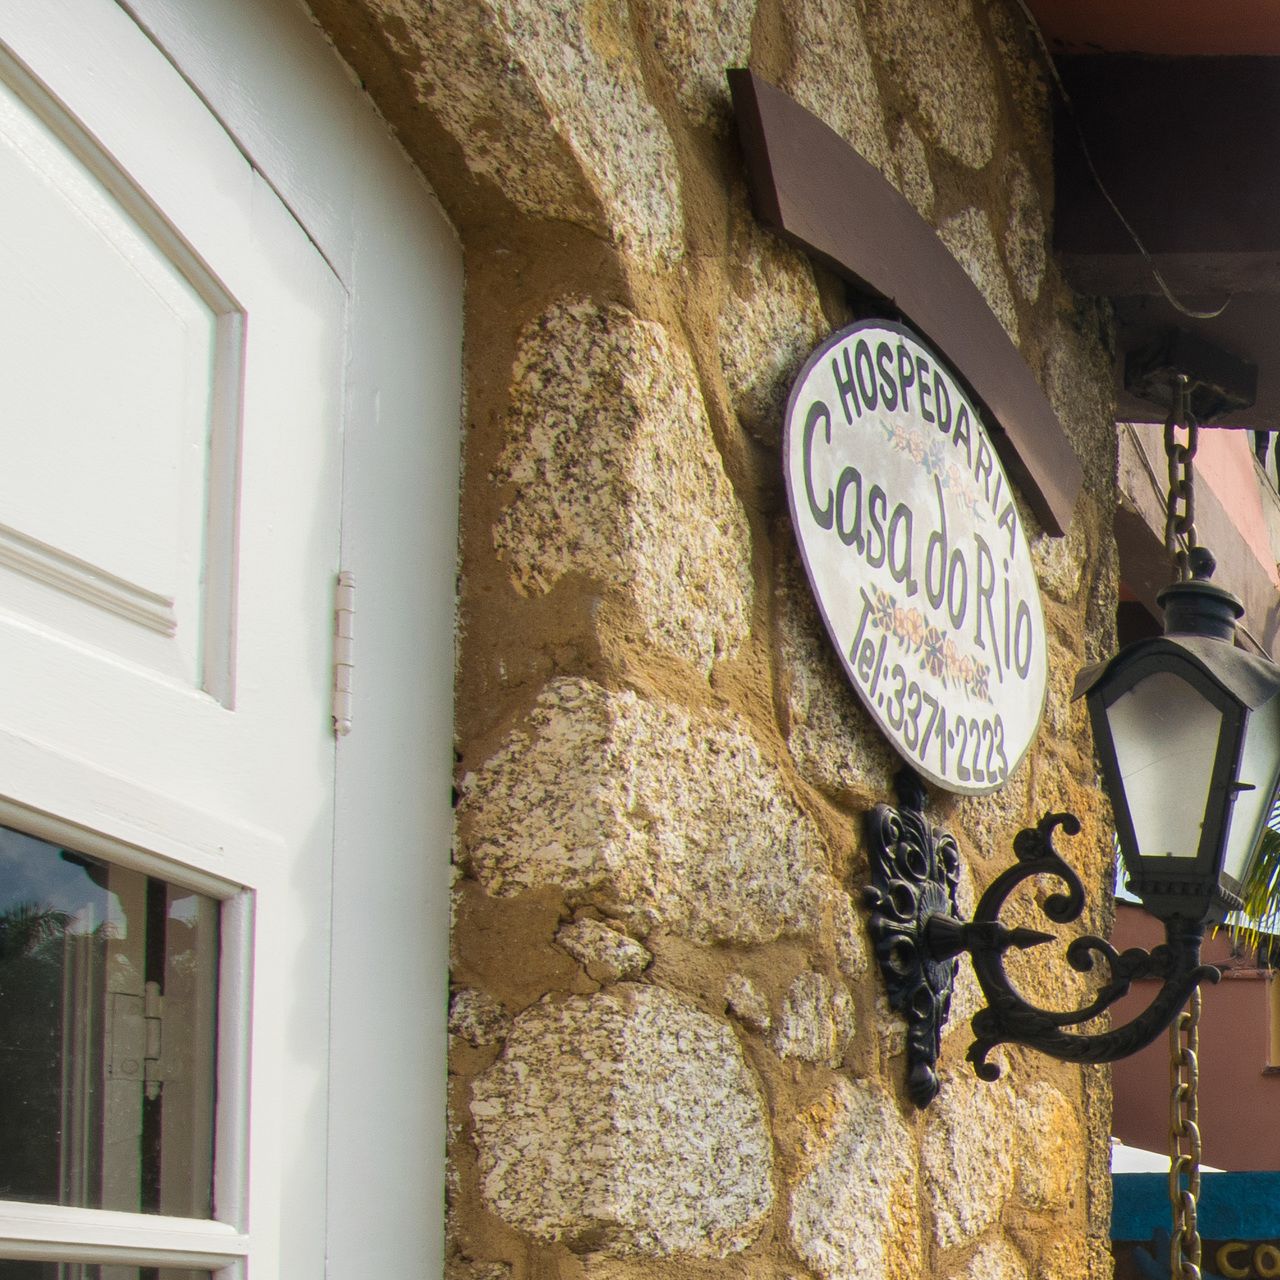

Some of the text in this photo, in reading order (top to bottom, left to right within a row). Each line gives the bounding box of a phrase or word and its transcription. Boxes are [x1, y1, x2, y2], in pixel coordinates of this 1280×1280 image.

[802, 400, 919, 598] Casa
[925, 473, 969, 631] do
[831, 338, 1017, 561] HOSPEDARIA
